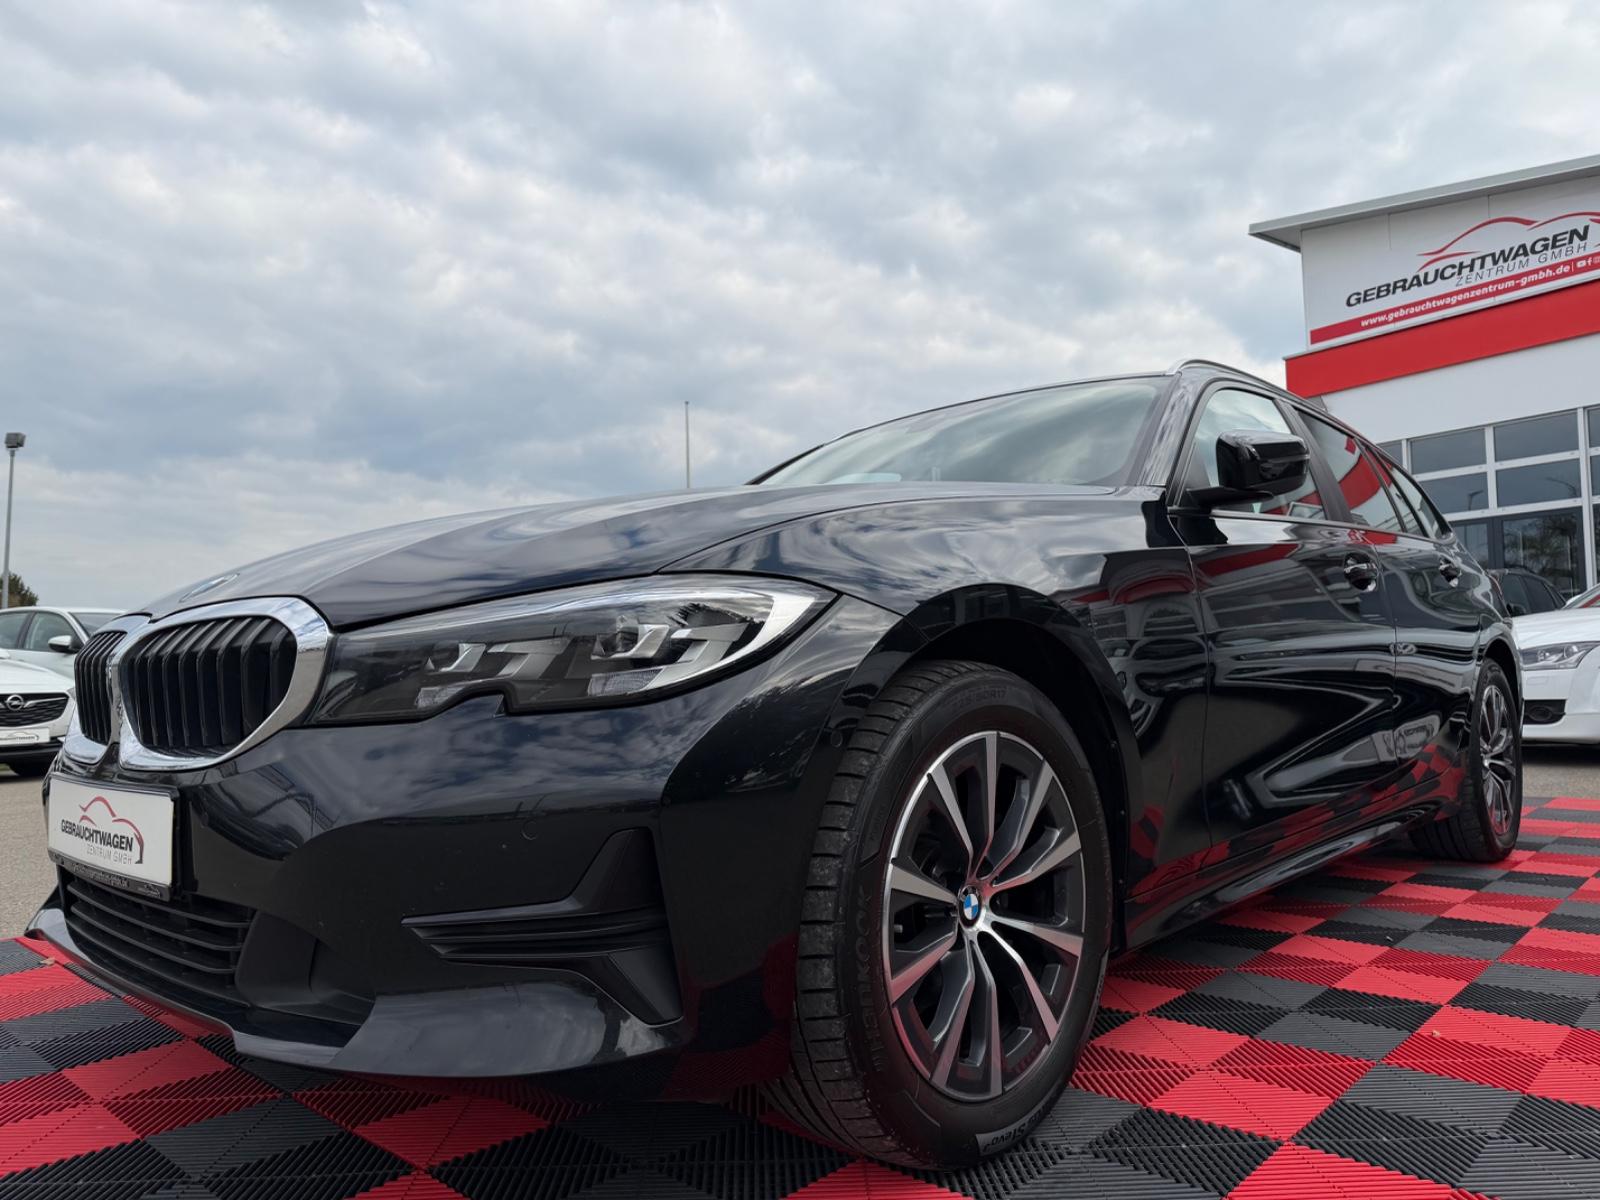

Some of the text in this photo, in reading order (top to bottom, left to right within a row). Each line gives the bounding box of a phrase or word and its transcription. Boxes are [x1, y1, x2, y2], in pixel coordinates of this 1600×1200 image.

[1345, 224, 1590, 308] GEBRAUCHTWAGEN
[1455, 241, 1588, 287] ZENTRUM GMBH
[1360, 264, 1571, 328] www.gebrauchtwagenzentrum-gmbh.de
[61, 819, 134, 852] GEBRAUCHTWAGEN
